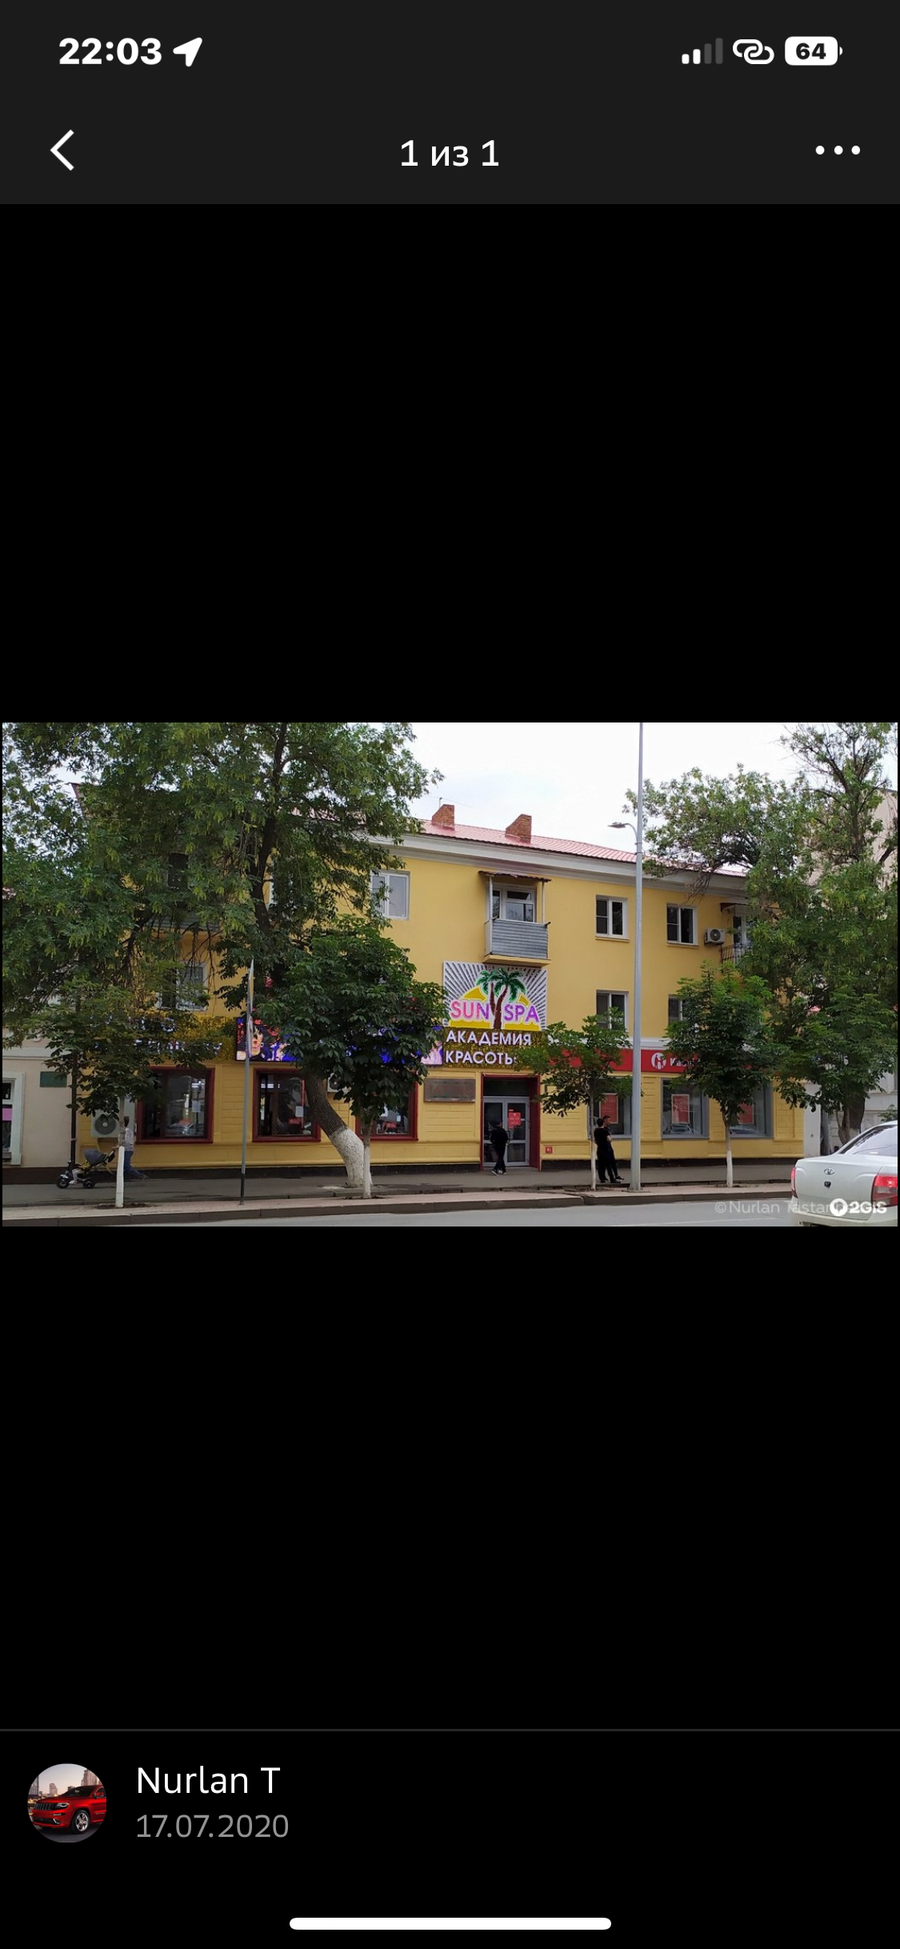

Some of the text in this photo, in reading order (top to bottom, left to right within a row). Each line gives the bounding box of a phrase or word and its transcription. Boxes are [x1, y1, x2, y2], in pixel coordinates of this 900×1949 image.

[451, 1000, 540, 1023] SUN SPA
[446, 1030, 532, 1046] АКАДЕМИЯ
